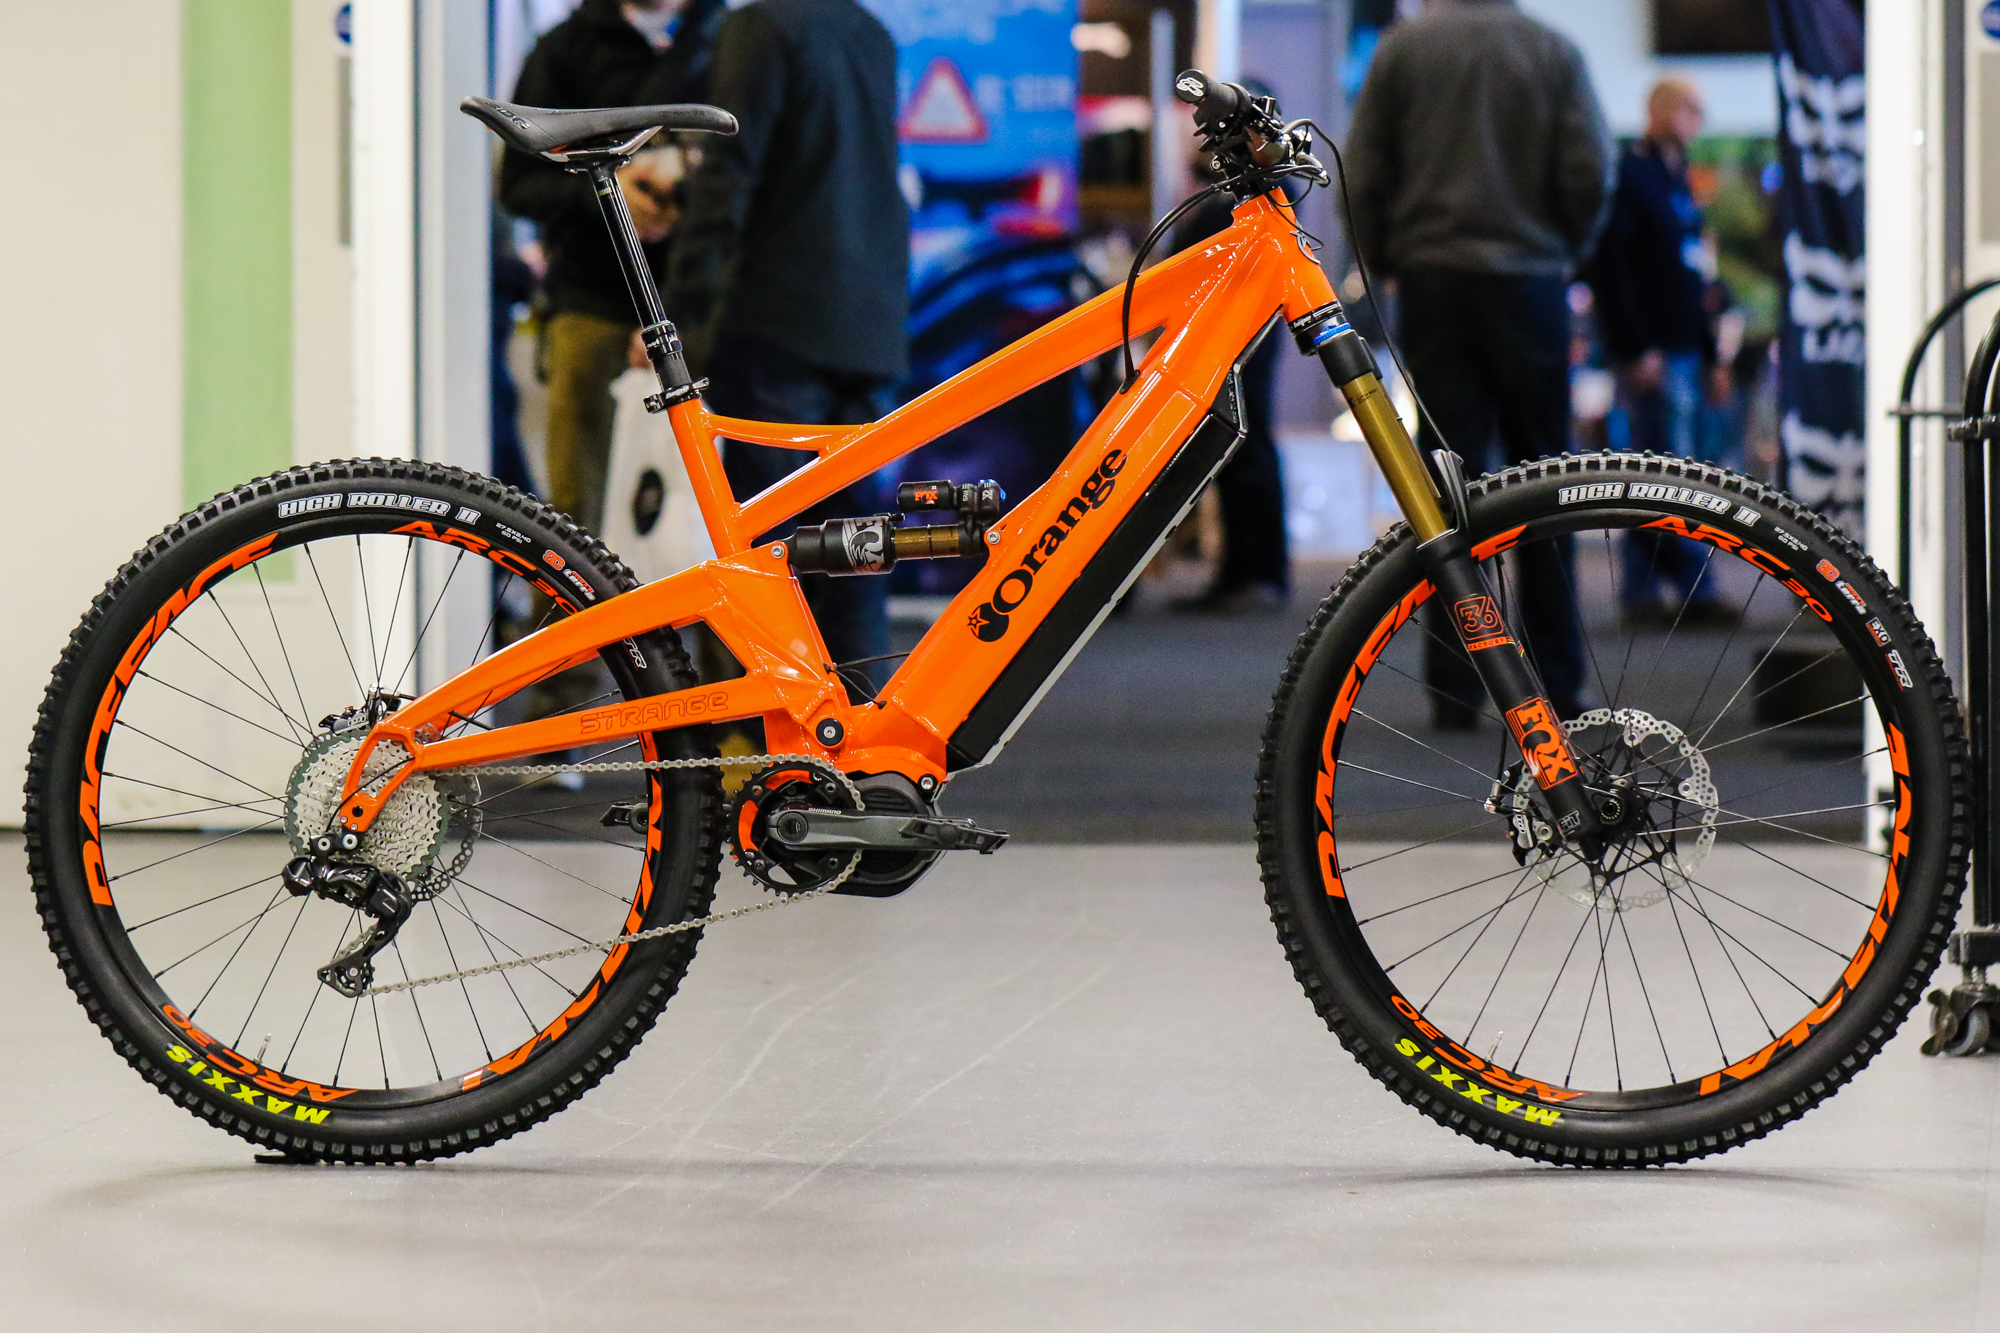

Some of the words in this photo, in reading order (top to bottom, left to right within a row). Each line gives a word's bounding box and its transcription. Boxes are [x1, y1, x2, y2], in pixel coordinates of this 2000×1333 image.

[278, 493, 342, 518] HIGH
[347, 493, 451, 516] ROLLER
[455, 507, 481, 525] II
[914, 490, 938, 505] FOX
[1559, 483, 1625, 505] HIGH
[1628, 483, 1731, 514] ROLLER
[1733, 506, 1761, 527] II
[992, 449, 1127, 614] Orange
[388, 520, 537, 576] ARC
[531, 578, 579, 616] 30
[1638, 516, 1790, 575] ARC
[1781, 578, 1833, 622] 30
[1460, 598, 1499, 633] 36
[1871, 619, 1890, 645] EXO
[1469, 638, 1505, 650] FACTORY
[1888, 649, 1913, 688] TR
[580, 691, 729, 734] STRANGE
[1514, 700, 1577, 784] FOX
[808, 807, 842, 815] SHIMANO
[162, 1005, 217, 1047] 30
[1391, 995, 1444, 1040] 30
[166, 1043, 332, 1124] MAXXIS
[206, 1048, 360, 1103] ARC
[1394, 1038, 1561, 1126] MAXXIS
[1433, 1042, 1589, 1103] ARC
